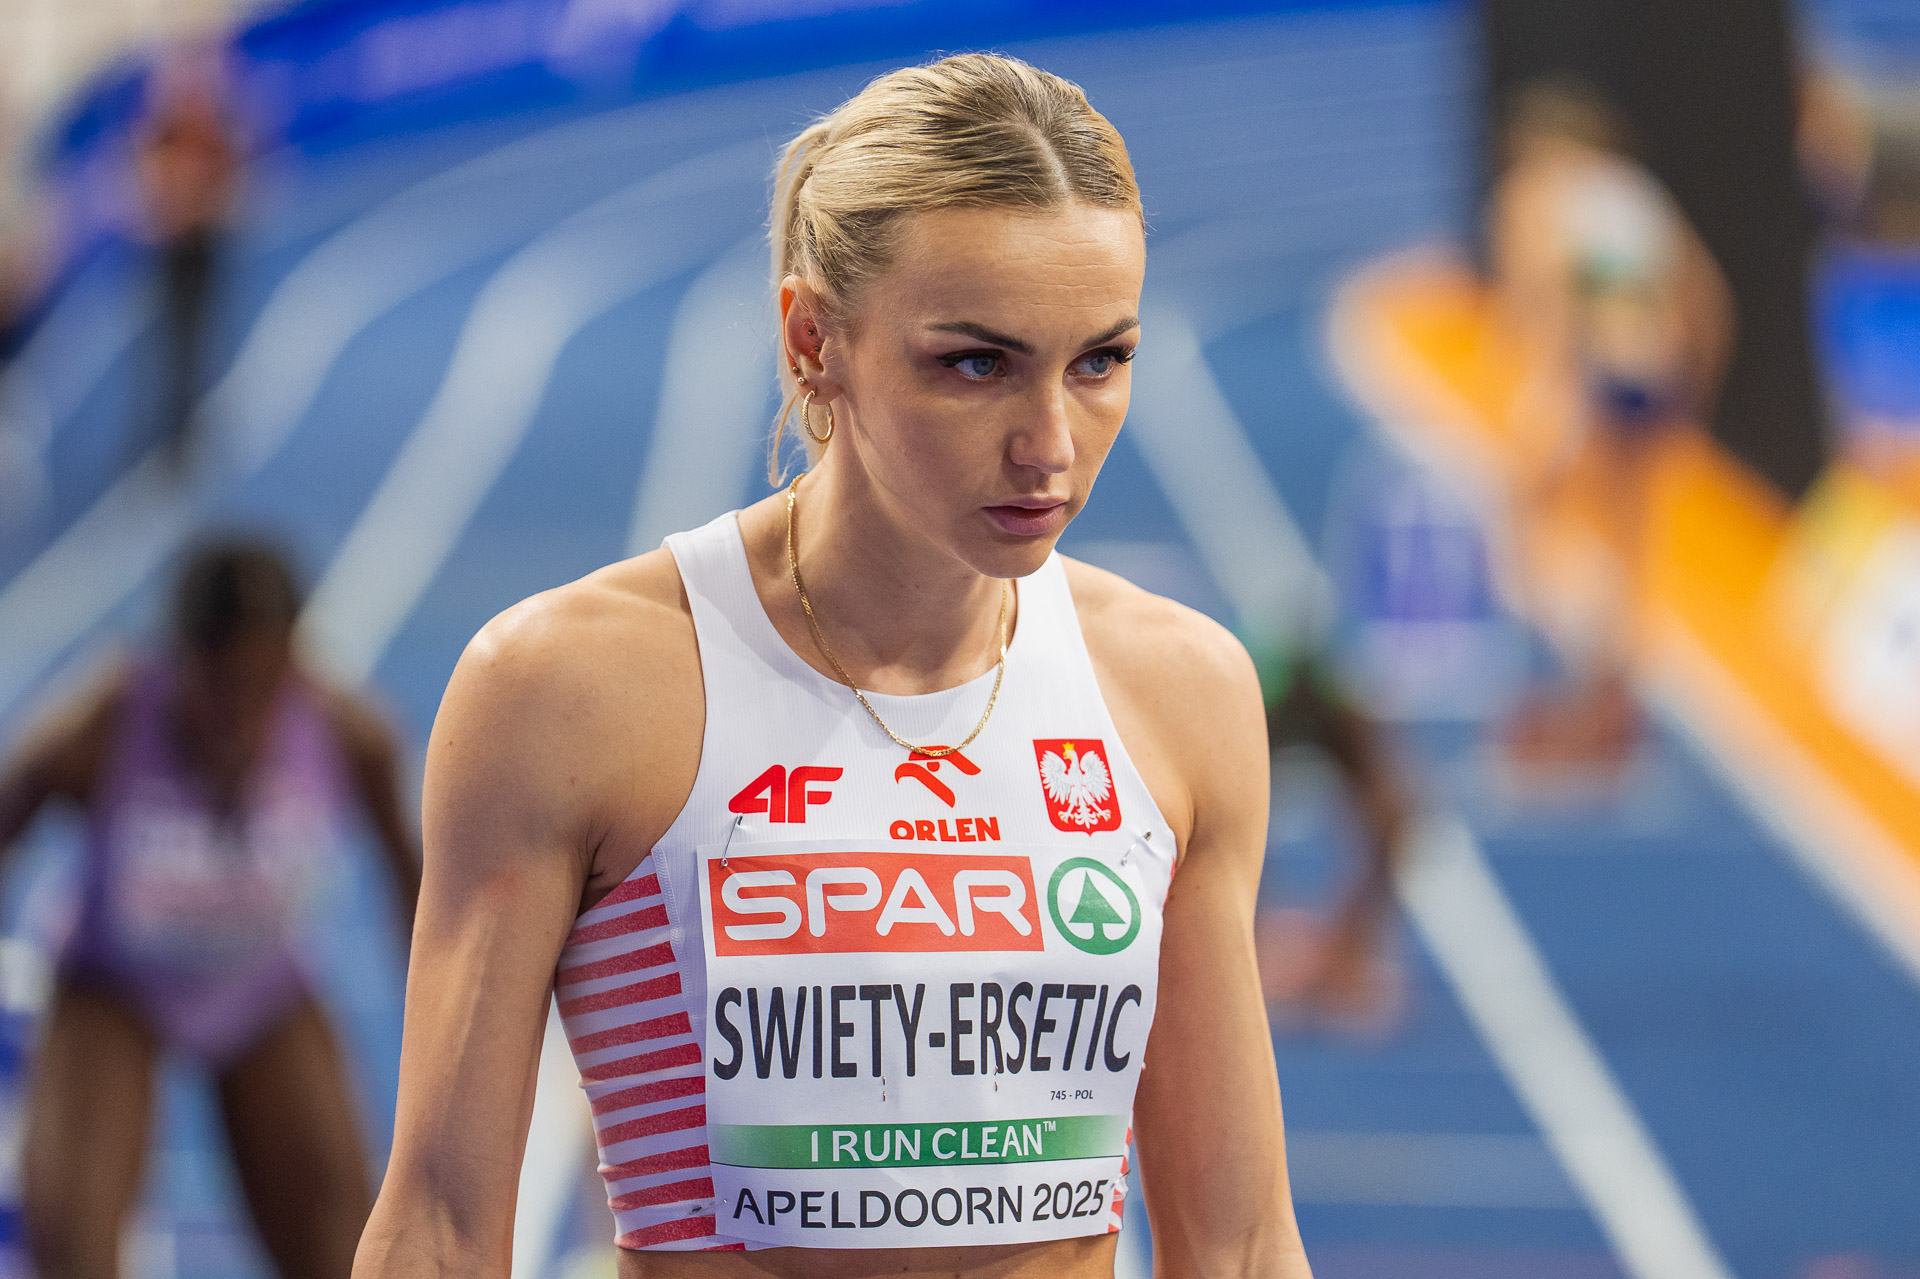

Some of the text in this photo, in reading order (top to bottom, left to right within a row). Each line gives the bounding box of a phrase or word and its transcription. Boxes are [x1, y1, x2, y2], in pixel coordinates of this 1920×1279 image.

[728, 764, 844, 824] 4F
[889, 816, 1001, 842] ORLEN
[721, 866, 1034, 941] SPAR
[713, 981, 1142, 1080] SWIETY-ERSETIC
[1050, 1090, 1067, 1100] 745
[1074, 1089, 1094, 1100] POL
[810, 1130, 819, 1163] I
[832, 1128, 921, 1162] RUN
[732, 1178, 1109, 1229] APELDOORN 2025
